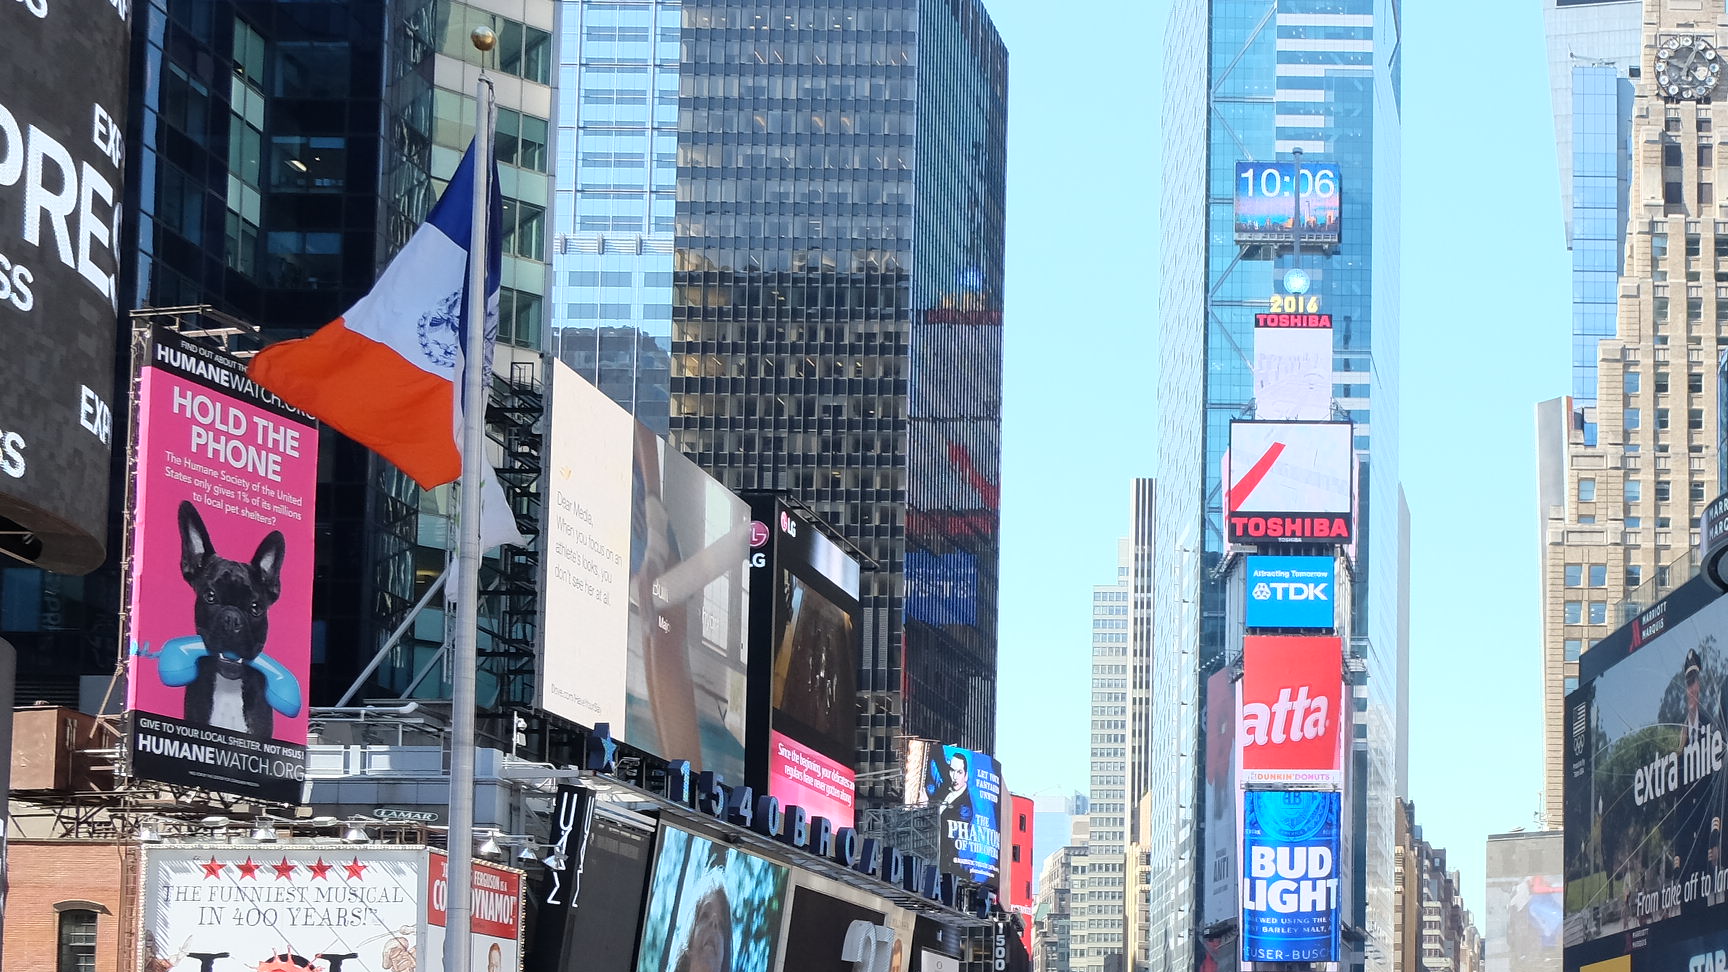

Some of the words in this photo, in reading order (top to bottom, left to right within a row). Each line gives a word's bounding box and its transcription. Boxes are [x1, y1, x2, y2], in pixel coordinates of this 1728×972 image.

[1270, 293, 1319, 313] 2016
[1256, 314, 1331, 328] TOSHIBA
[172, 386, 247, 436] HOLD
[253, 416, 300, 458] THE
[191, 425, 282, 483] PHONE
[165, 466, 192, 484] States
[194, 477, 212, 493] only
[214, 484, 235, 499] gives
[184, 458, 219, 479] Humane
[220, 471, 250, 490] Society
[277, 489, 303, 507] United
[1231, 516, 1349, 538] TOSHIBA
[1271, 583, 1328, 600] TDK
[1642, 601, 1667, 623] MARRIOTT
[1642, 618, 1664, 640] MARQUIS
[140, 717, 160, 731] GIVE
[162, 722, 175, 734] TO
[176, 725, 199, 737] YOUR
[200, 730, 228, 744] LOCAL
[138, 733, 305, 782] HUMANEWATCH.ORG
[1634, 751, 1678, 806] extra
[1684, 724, 1723, 785] mile
[673, 759, 780, 838] 1540
[785, 805, 960, 906] BROADWAY
[1251, 846, 1332, 879] BUD
[163, 884, 200, 903] THE
[208, 885, 310, 903] FUNNIEST
[315, 885, 404, 903] MUSICAL
[1243, 878, 1338, 913] LIGHT
[1636, 891, 1659, 917] From
[1661, 881, 1681, 909] take
[1684, 872, 1698, 903] off
[1701, 873, 1711, 897] to
[198, 907, 224, 926] IN
[232, 906, 279, 928] 400
